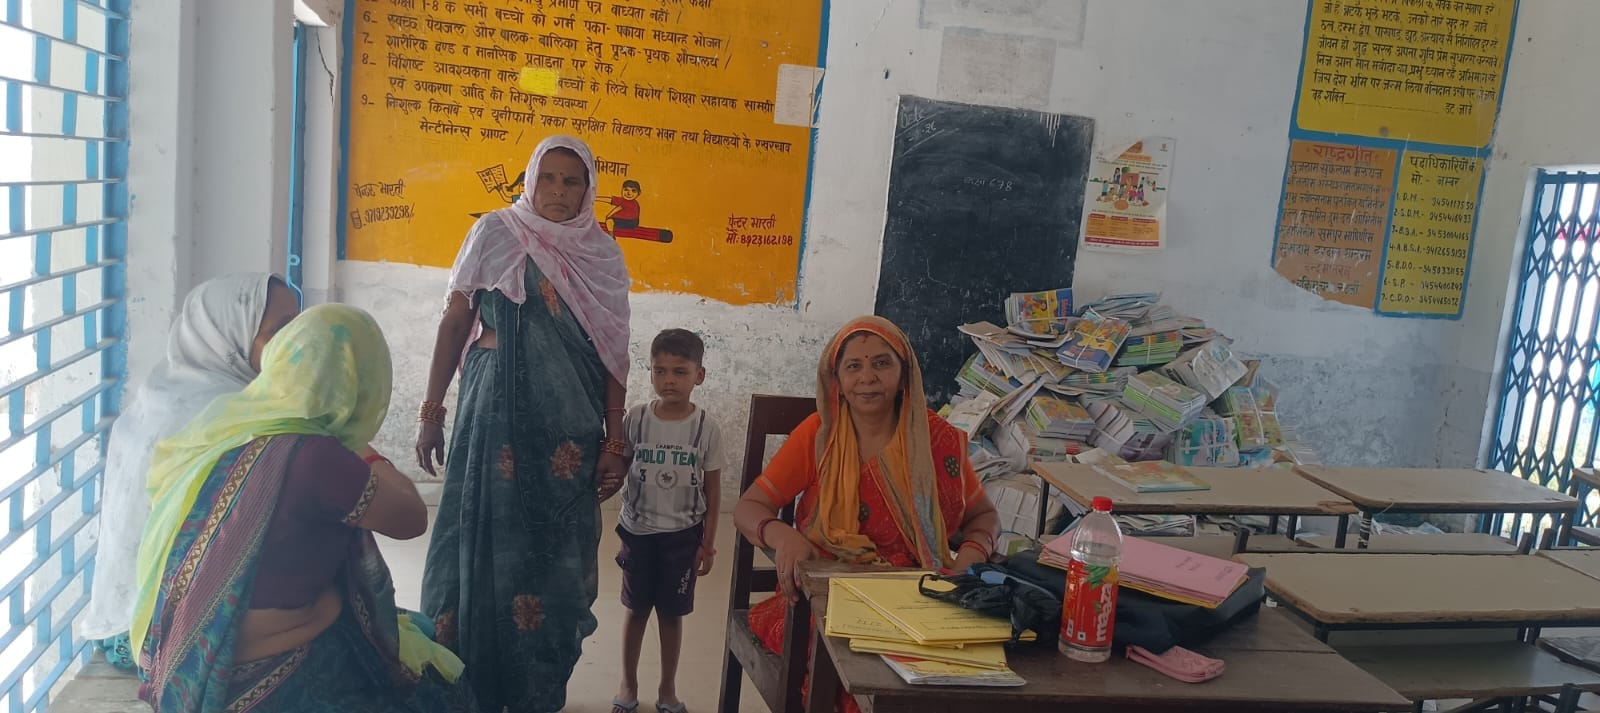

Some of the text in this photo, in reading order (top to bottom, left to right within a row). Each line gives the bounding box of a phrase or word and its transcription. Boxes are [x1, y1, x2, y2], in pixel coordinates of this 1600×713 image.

[425, 14, 467, 35] पेयजल
[474, 22, 496, 43] और
[538, 32, 577, 51] बालिका
[586, 36, 603, 58] हेतु
[495, 6, 525, 24] बच्चों
[531, 10, 546, 27] को
[553, 13, 576, 31] गर्म
[693, 32, 722, 49] भोजन
[386, 33, 428, 52] शारीरिक
[463, 45, 471, 57] व
[571, 59, 588, 73] पर
[594, 59, 614, 75] रोक
[388, 75, 406, 93] एवं
[413, 79, 453, 97] उपकरण
[460, 82, 485, 103] आदि
[433, 61, 491, 82] आवश्यकता
[590, 80, 600, 94] के
[606, 79, 628, 98] लिये
[667, 88, 697, 108] शिक्षा
[701, 94, 738, 111] सहायक
[469, 104, 484, 119] एवं
[612, 118, 652, 140] विद्यालय
[750, 214, 777, 230] भारती
[639, 468, 647, 482] 3
